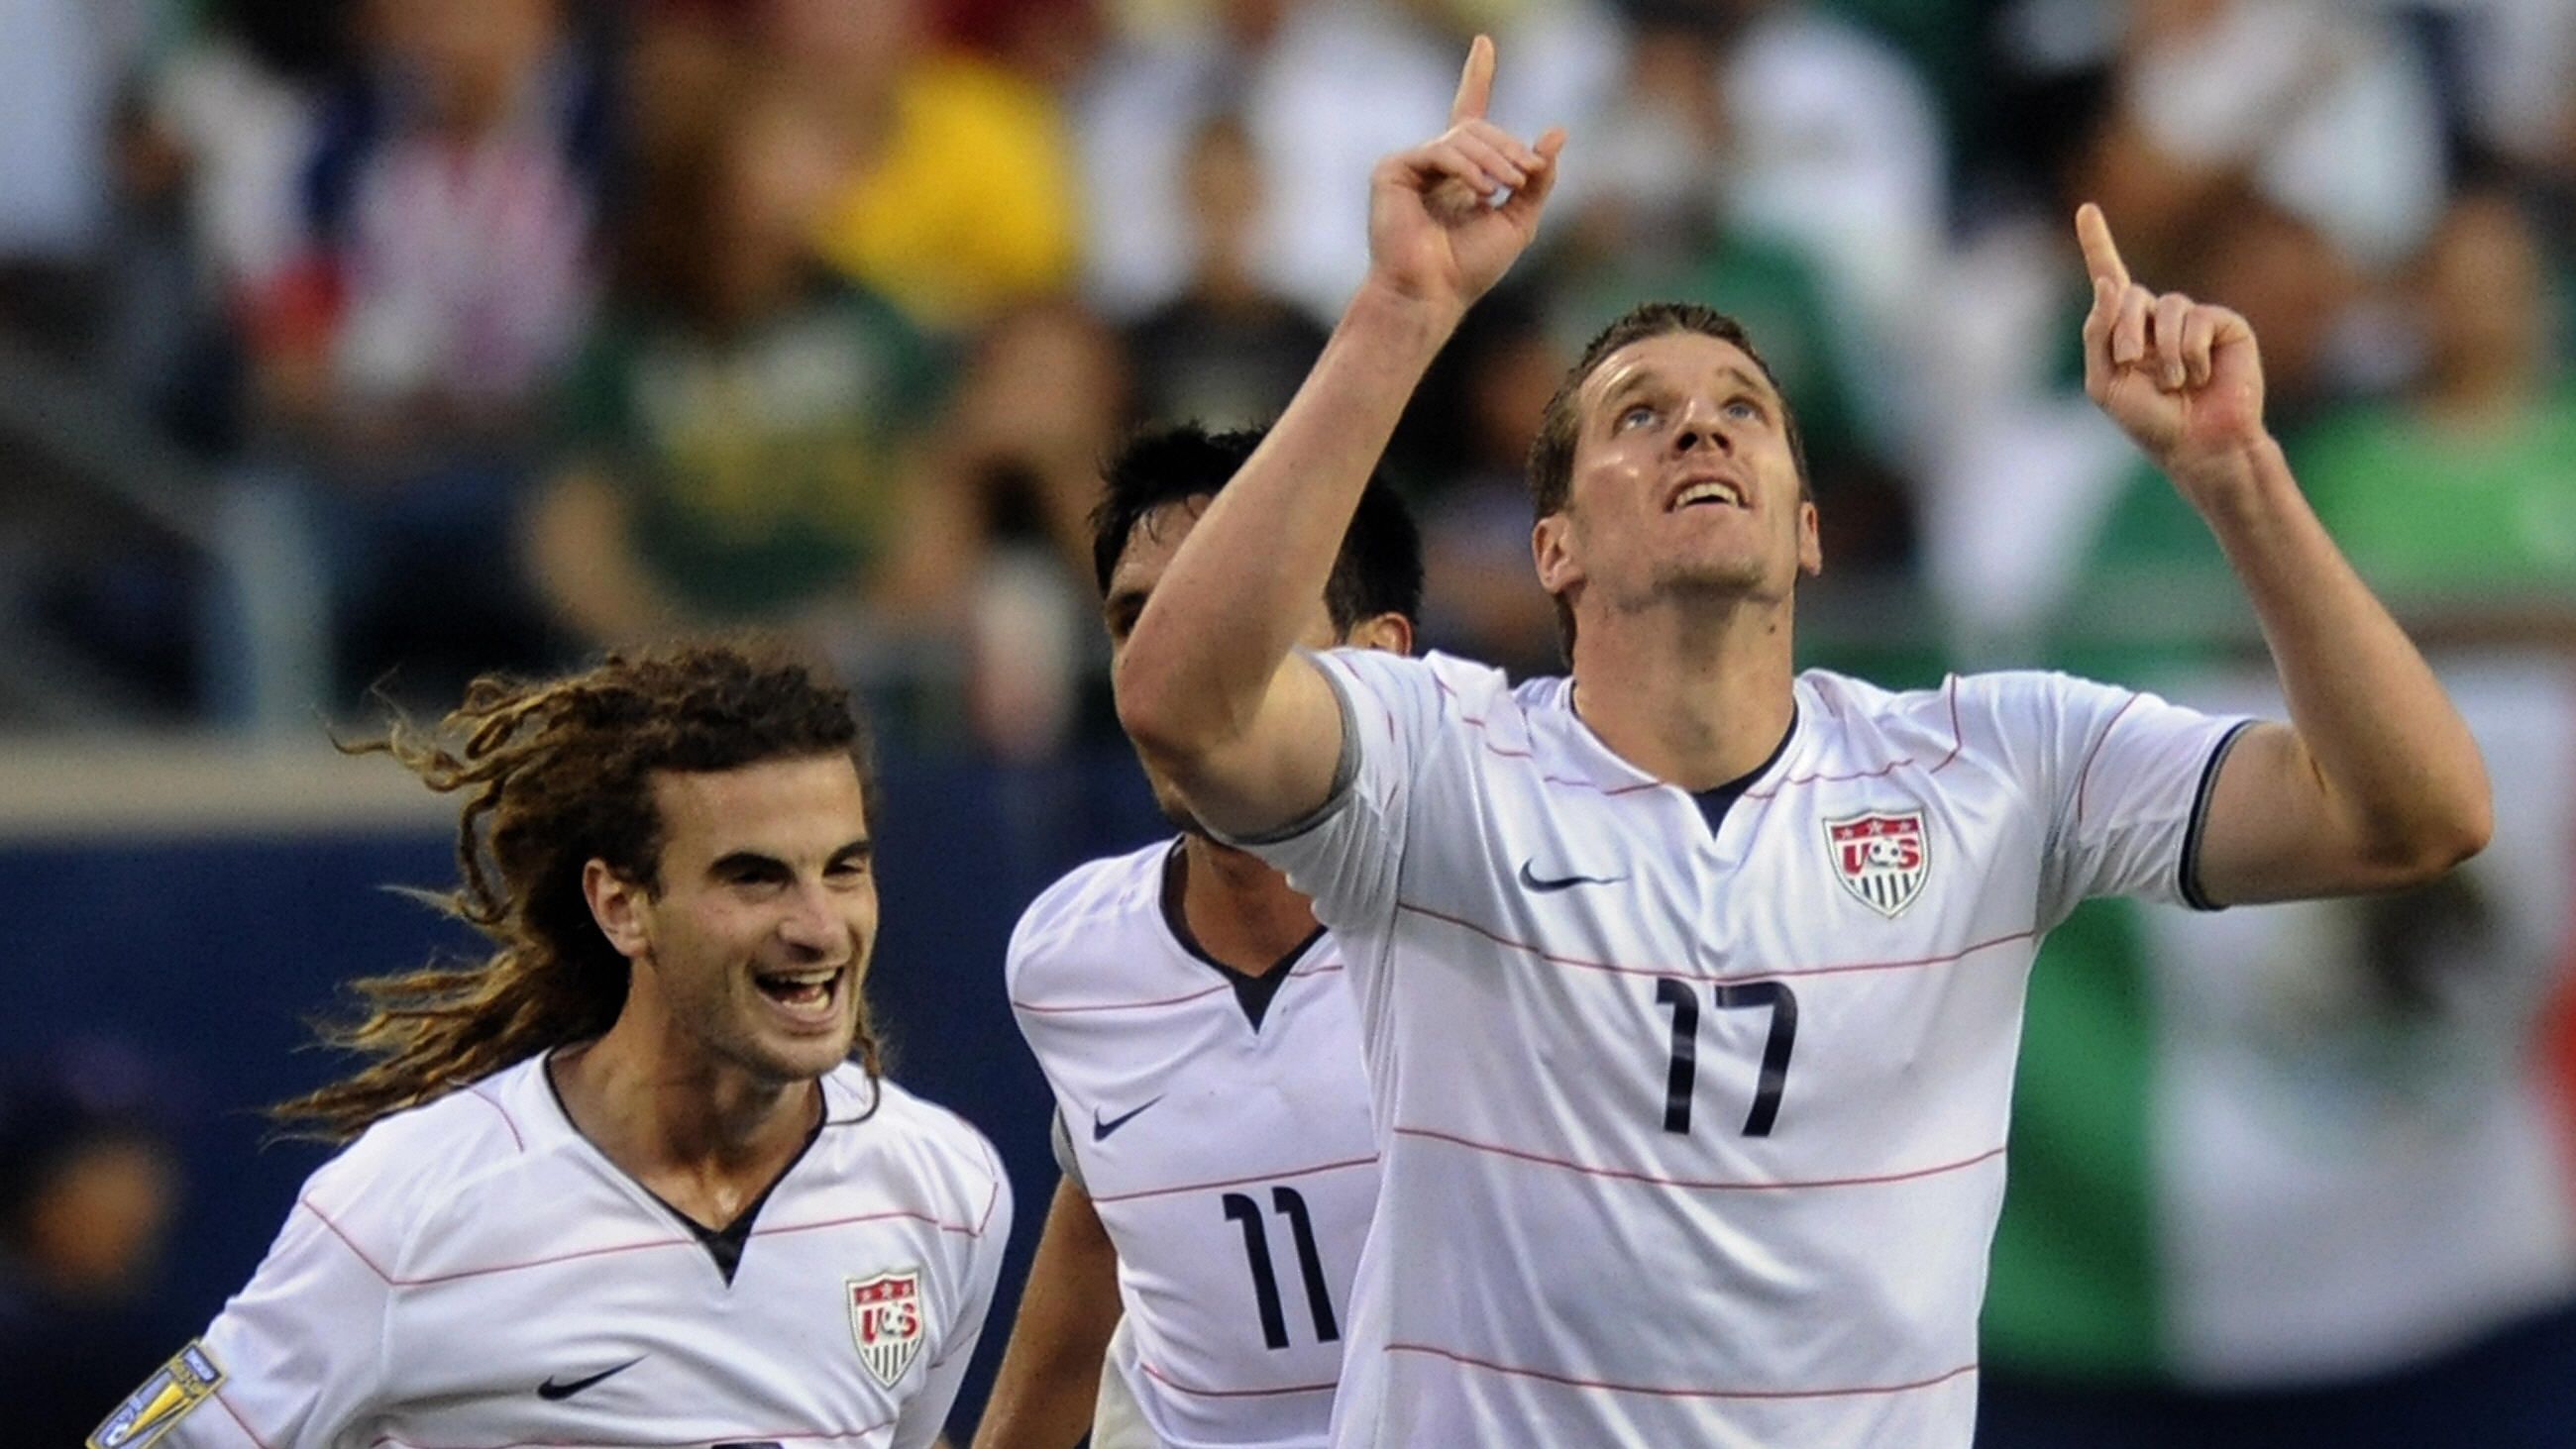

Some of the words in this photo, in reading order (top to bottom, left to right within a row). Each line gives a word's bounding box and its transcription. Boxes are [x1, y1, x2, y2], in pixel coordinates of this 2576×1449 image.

[1843, 838, 1920, 875] US
[1656, 977, 1798, 1138] 17
[1222, 1186, 1340, 1350] 11
